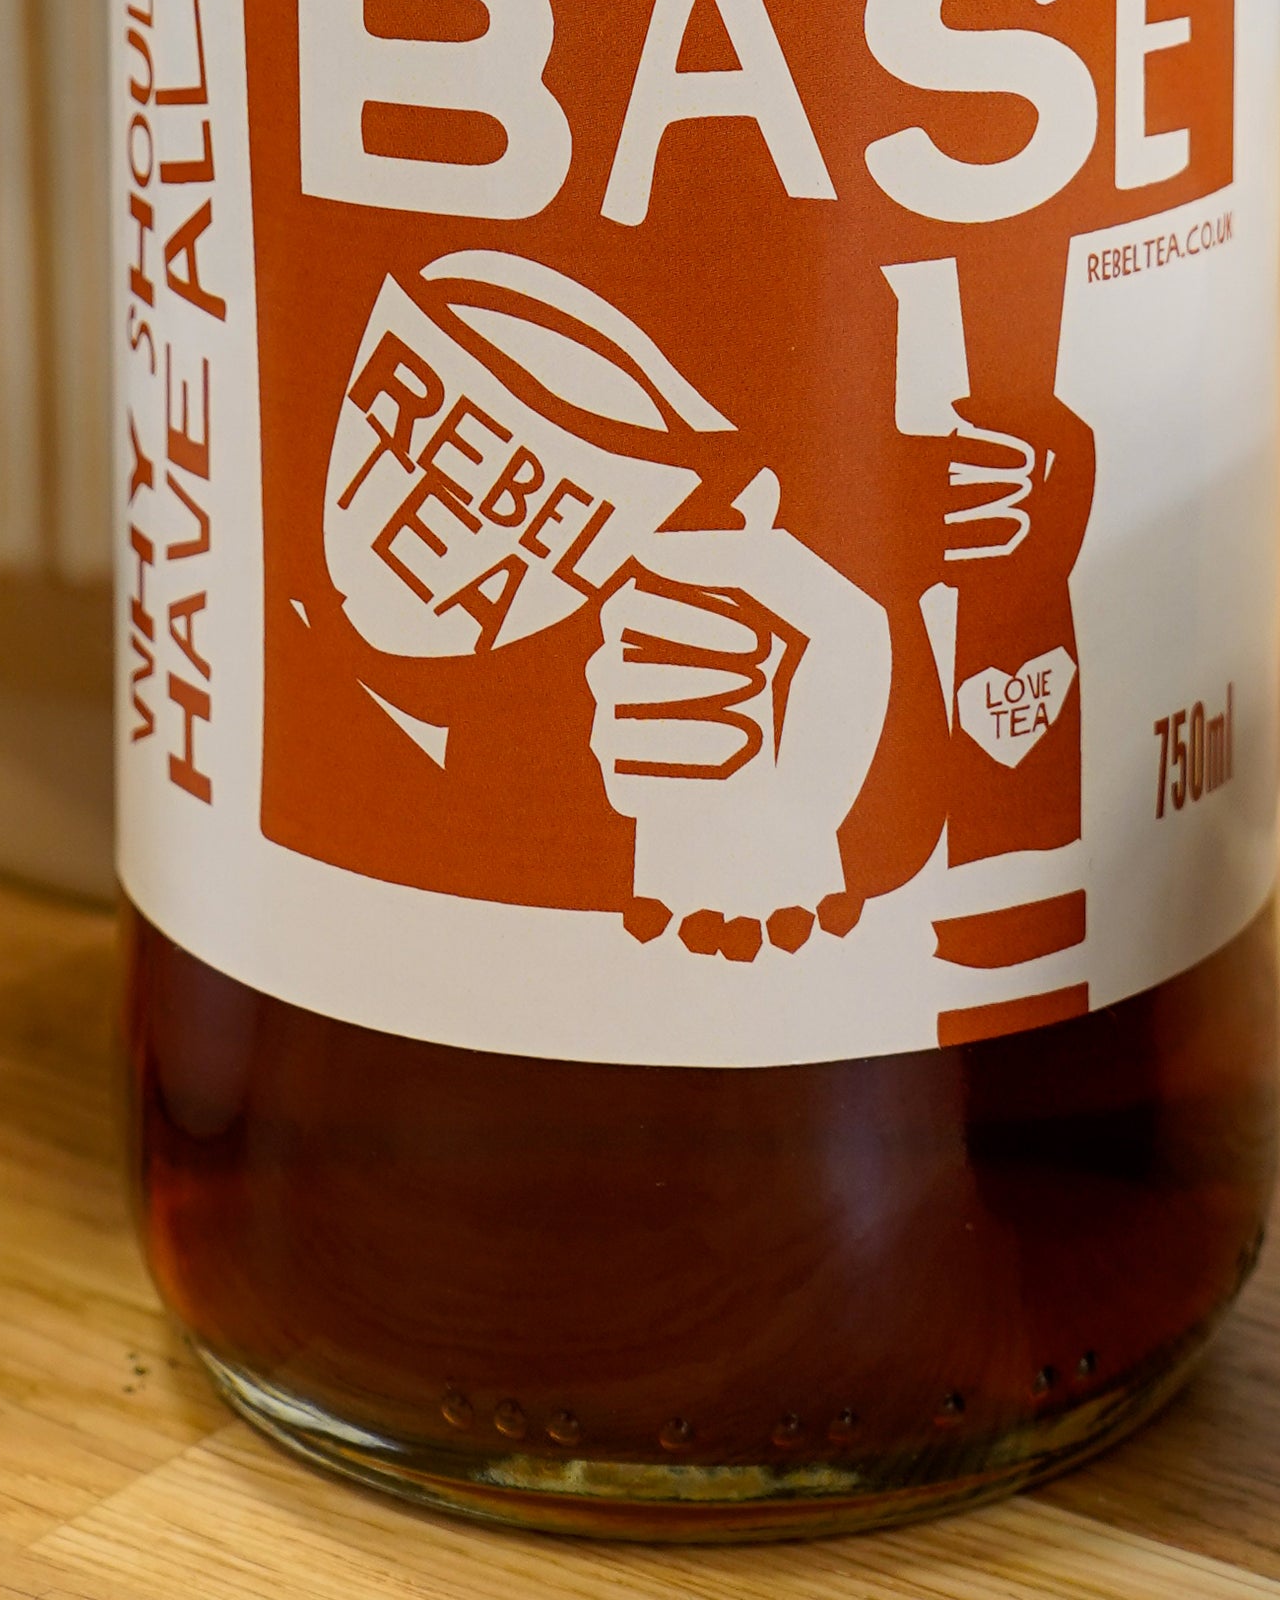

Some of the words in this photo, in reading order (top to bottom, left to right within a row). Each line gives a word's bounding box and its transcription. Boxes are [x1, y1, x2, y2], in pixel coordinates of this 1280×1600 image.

[1087, 211, 1233, 284] REBELTEA.CO.UK
[337, 412, 529, 654] TEA
[348, 329, 604, 602] REBEL
[127, 404, 157, 745] WHY
[164, 341, 214, 806] HAVE
[985, 669, 1053, 709] LOVE
[990, 702, 1050, 740] TEA
[1154, 681, 1233, 820] 750ml
